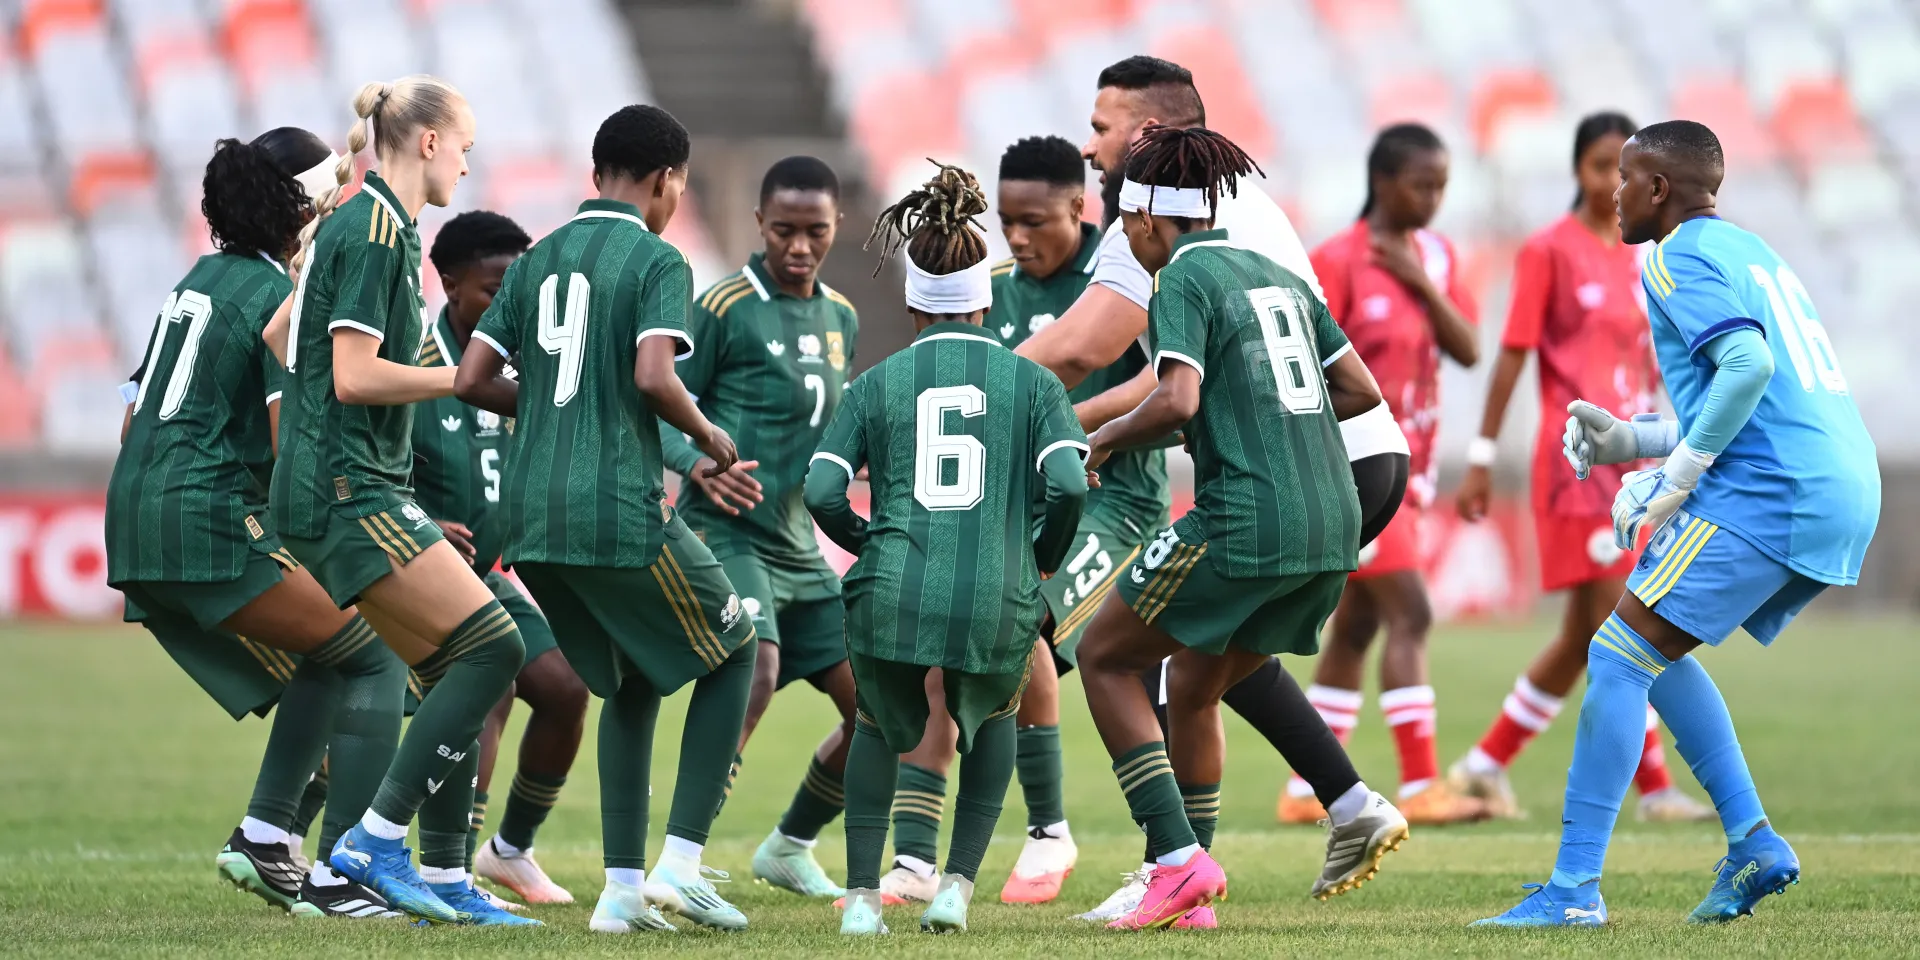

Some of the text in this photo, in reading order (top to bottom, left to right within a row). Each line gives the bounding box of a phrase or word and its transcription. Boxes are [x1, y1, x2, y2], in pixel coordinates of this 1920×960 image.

[537, 271, 590, 407] 4
[1249, 286, 1323, 414] 8
[1746, 264, 1849, 396] 16
[804, 374, 826, 428] 7
[914, 384, 986, 511] 6
[480, 448, 500, 502] 5
[1066, 532, 1114, 599] 13
